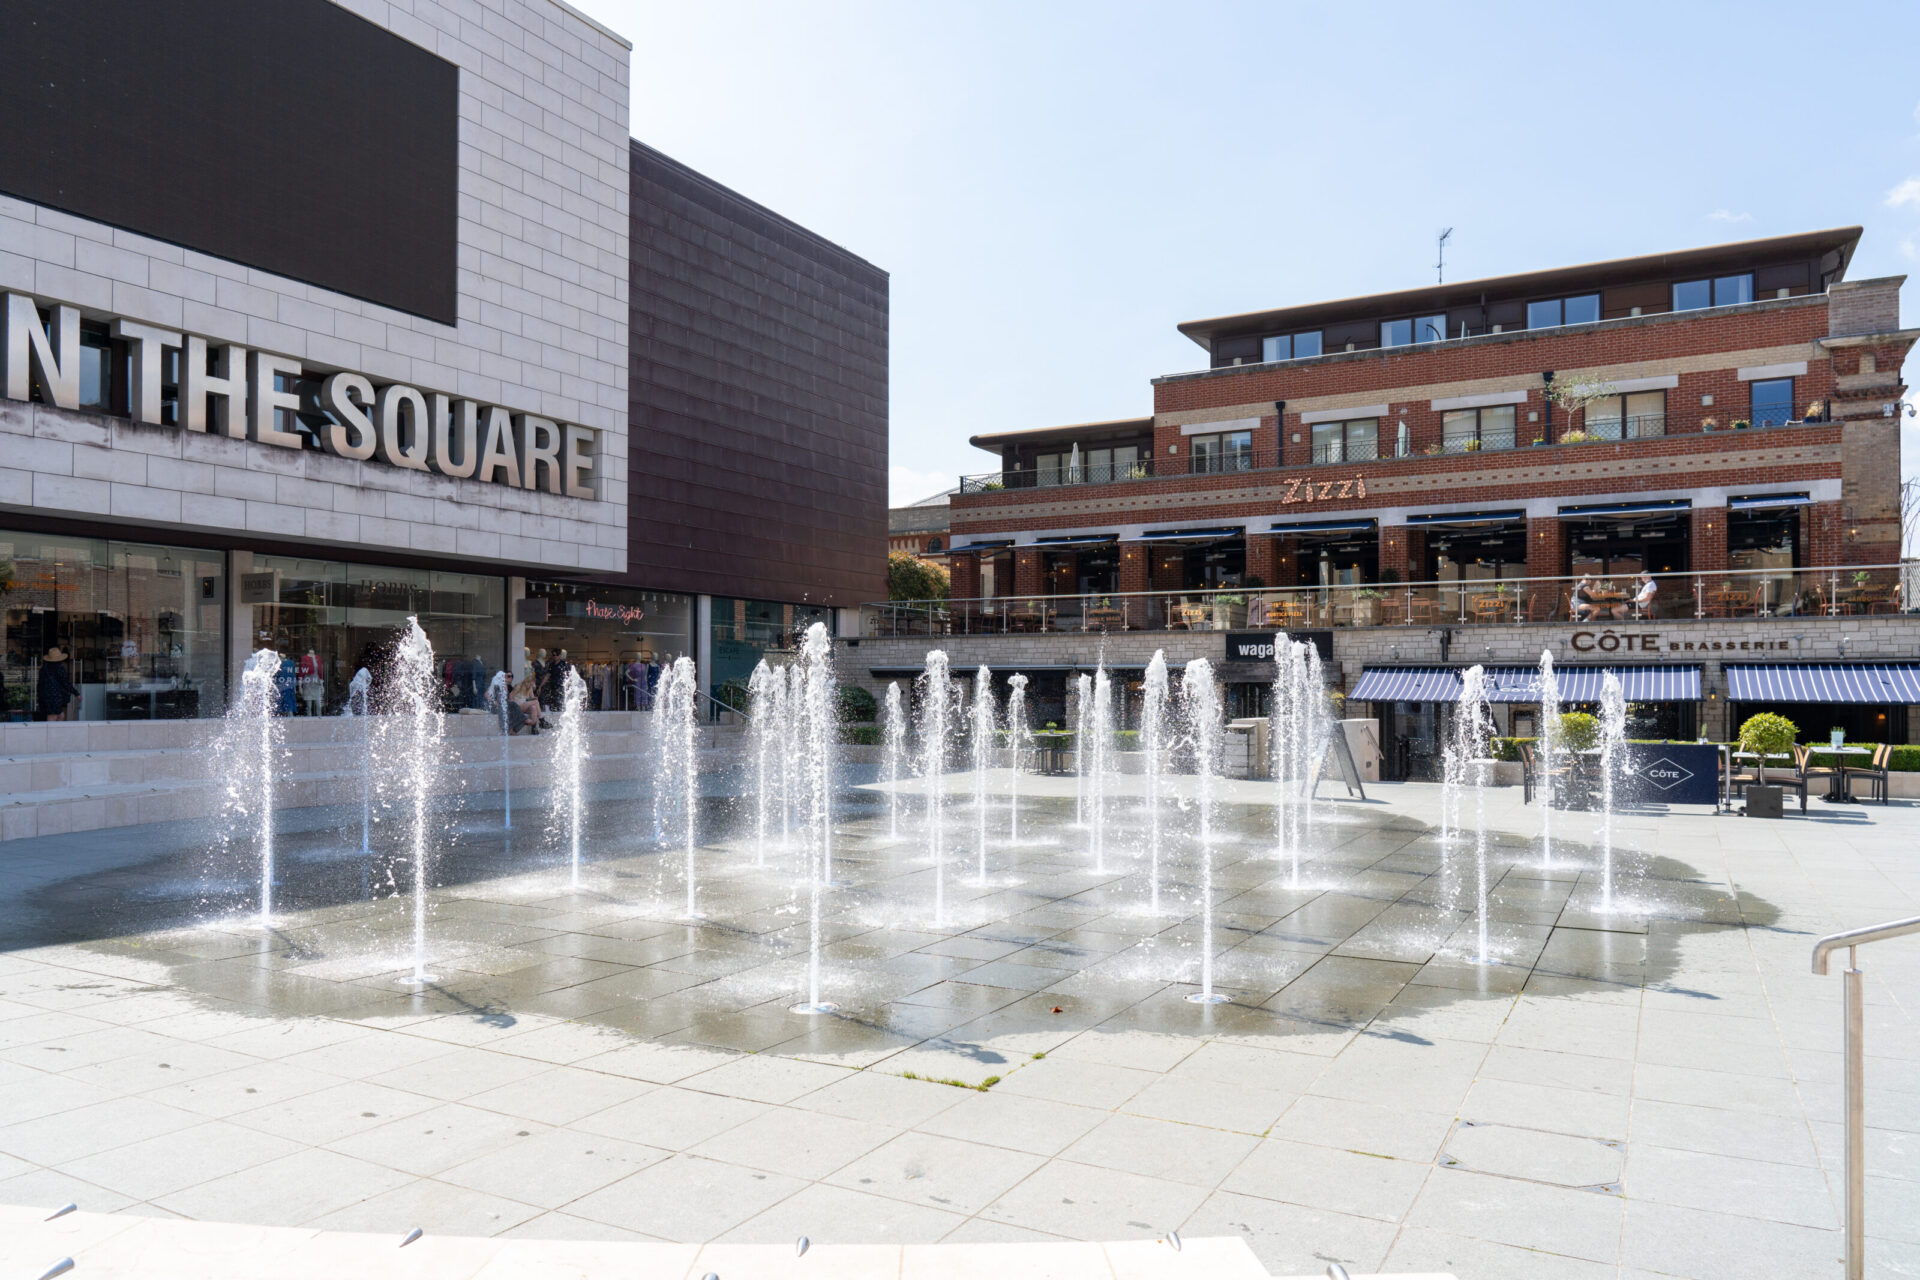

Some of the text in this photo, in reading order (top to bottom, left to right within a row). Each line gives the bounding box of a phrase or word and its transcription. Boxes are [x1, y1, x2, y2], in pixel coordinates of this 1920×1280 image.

[110, 318, 303, 450] THE
[320, 372, 603, 501] SQUARE
[1281, 473, 1366, 504] Zizzi
[244, 579, 272, 591] HOBBS
[360, 579, 417, 596] HOBBS
[586, 600, 644, 625] Phase Eight
[1571, 629, 1789, 651] CÔTE BRASSERIE
[287, 666, 310, 674] NEW
[1649, 768, 1680, 779] CÔTE
